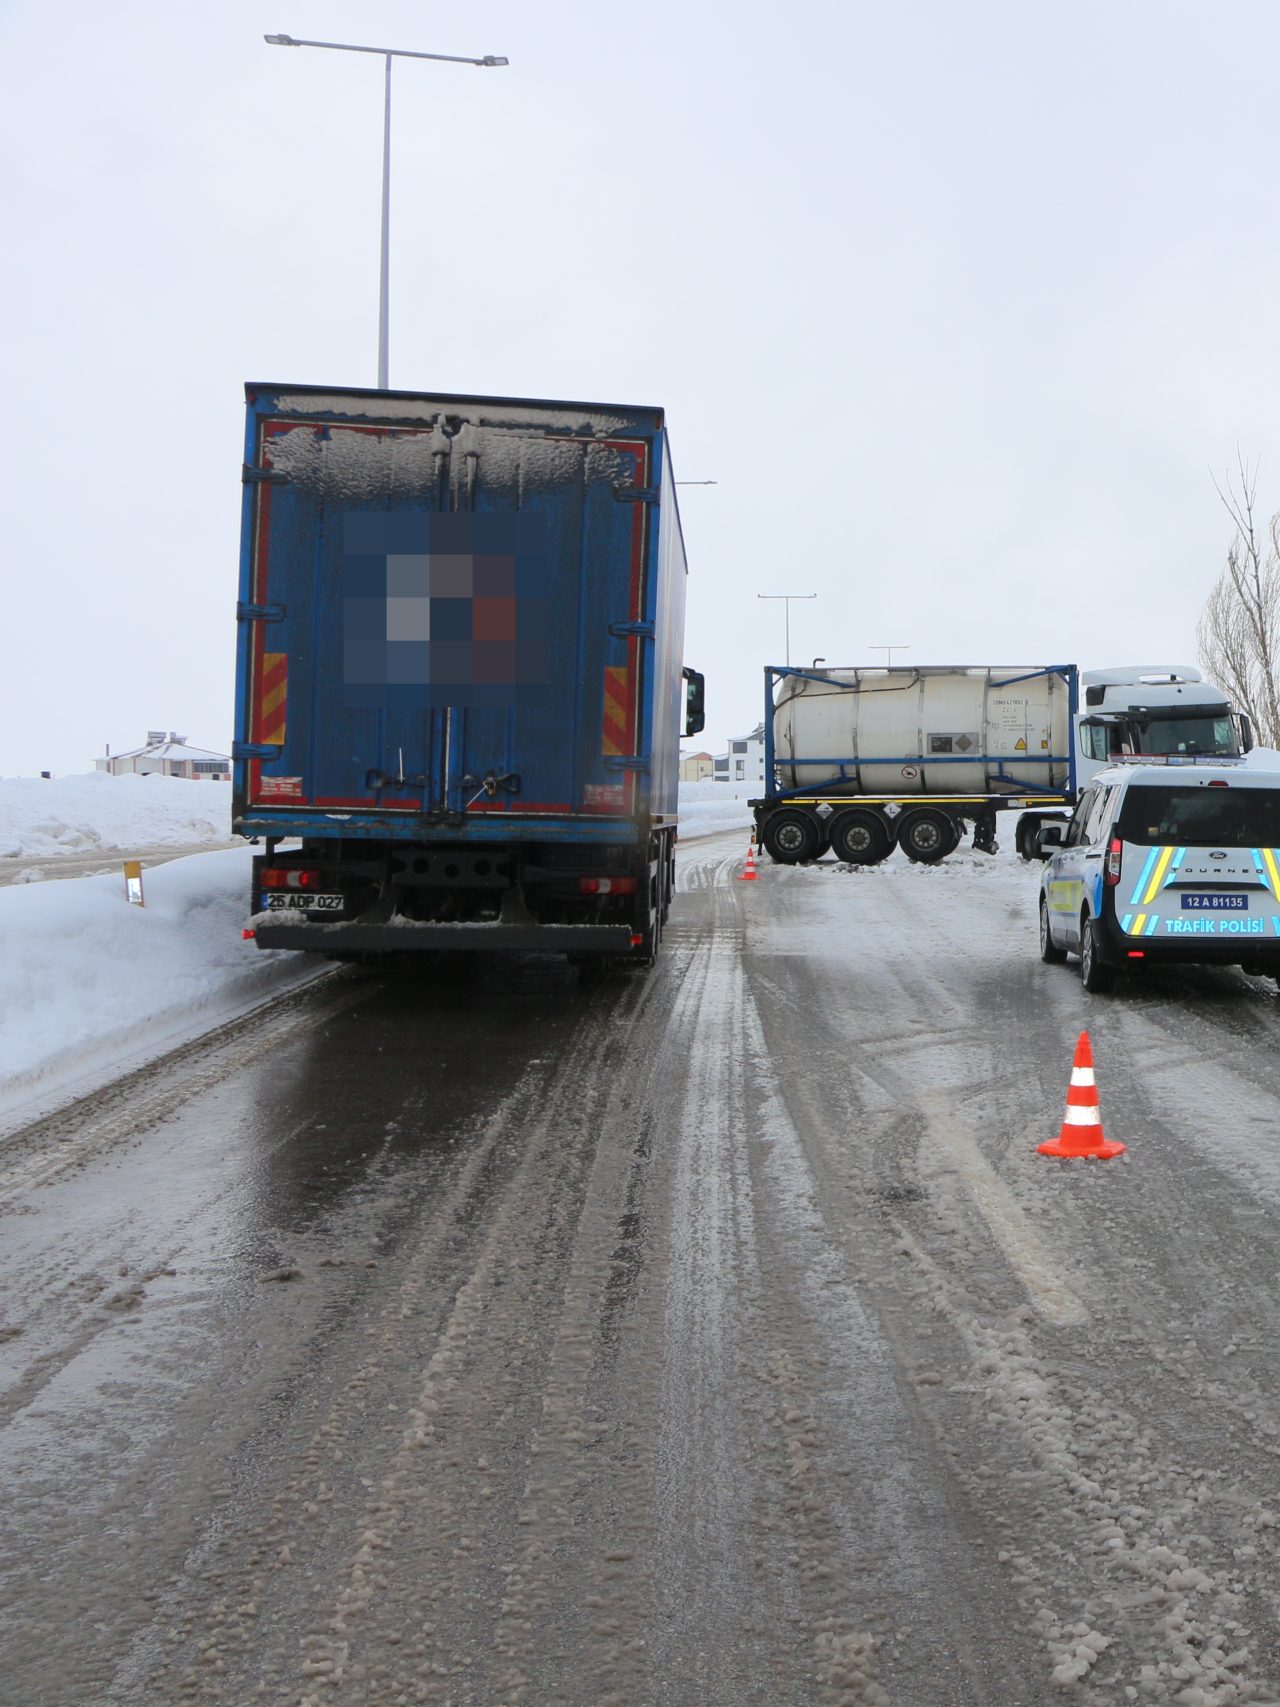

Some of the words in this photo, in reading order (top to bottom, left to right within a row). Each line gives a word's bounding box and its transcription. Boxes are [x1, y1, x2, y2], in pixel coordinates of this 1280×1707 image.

[268, 894, 285, 908] 25
[288, 894, 315, 909] ADP
[317, 895, 342, 909] 027
[1187, 897, 1200, 907] 12
[1202, 897, 1210, 907] A
[1212, 897, 1243, 907] 81135
